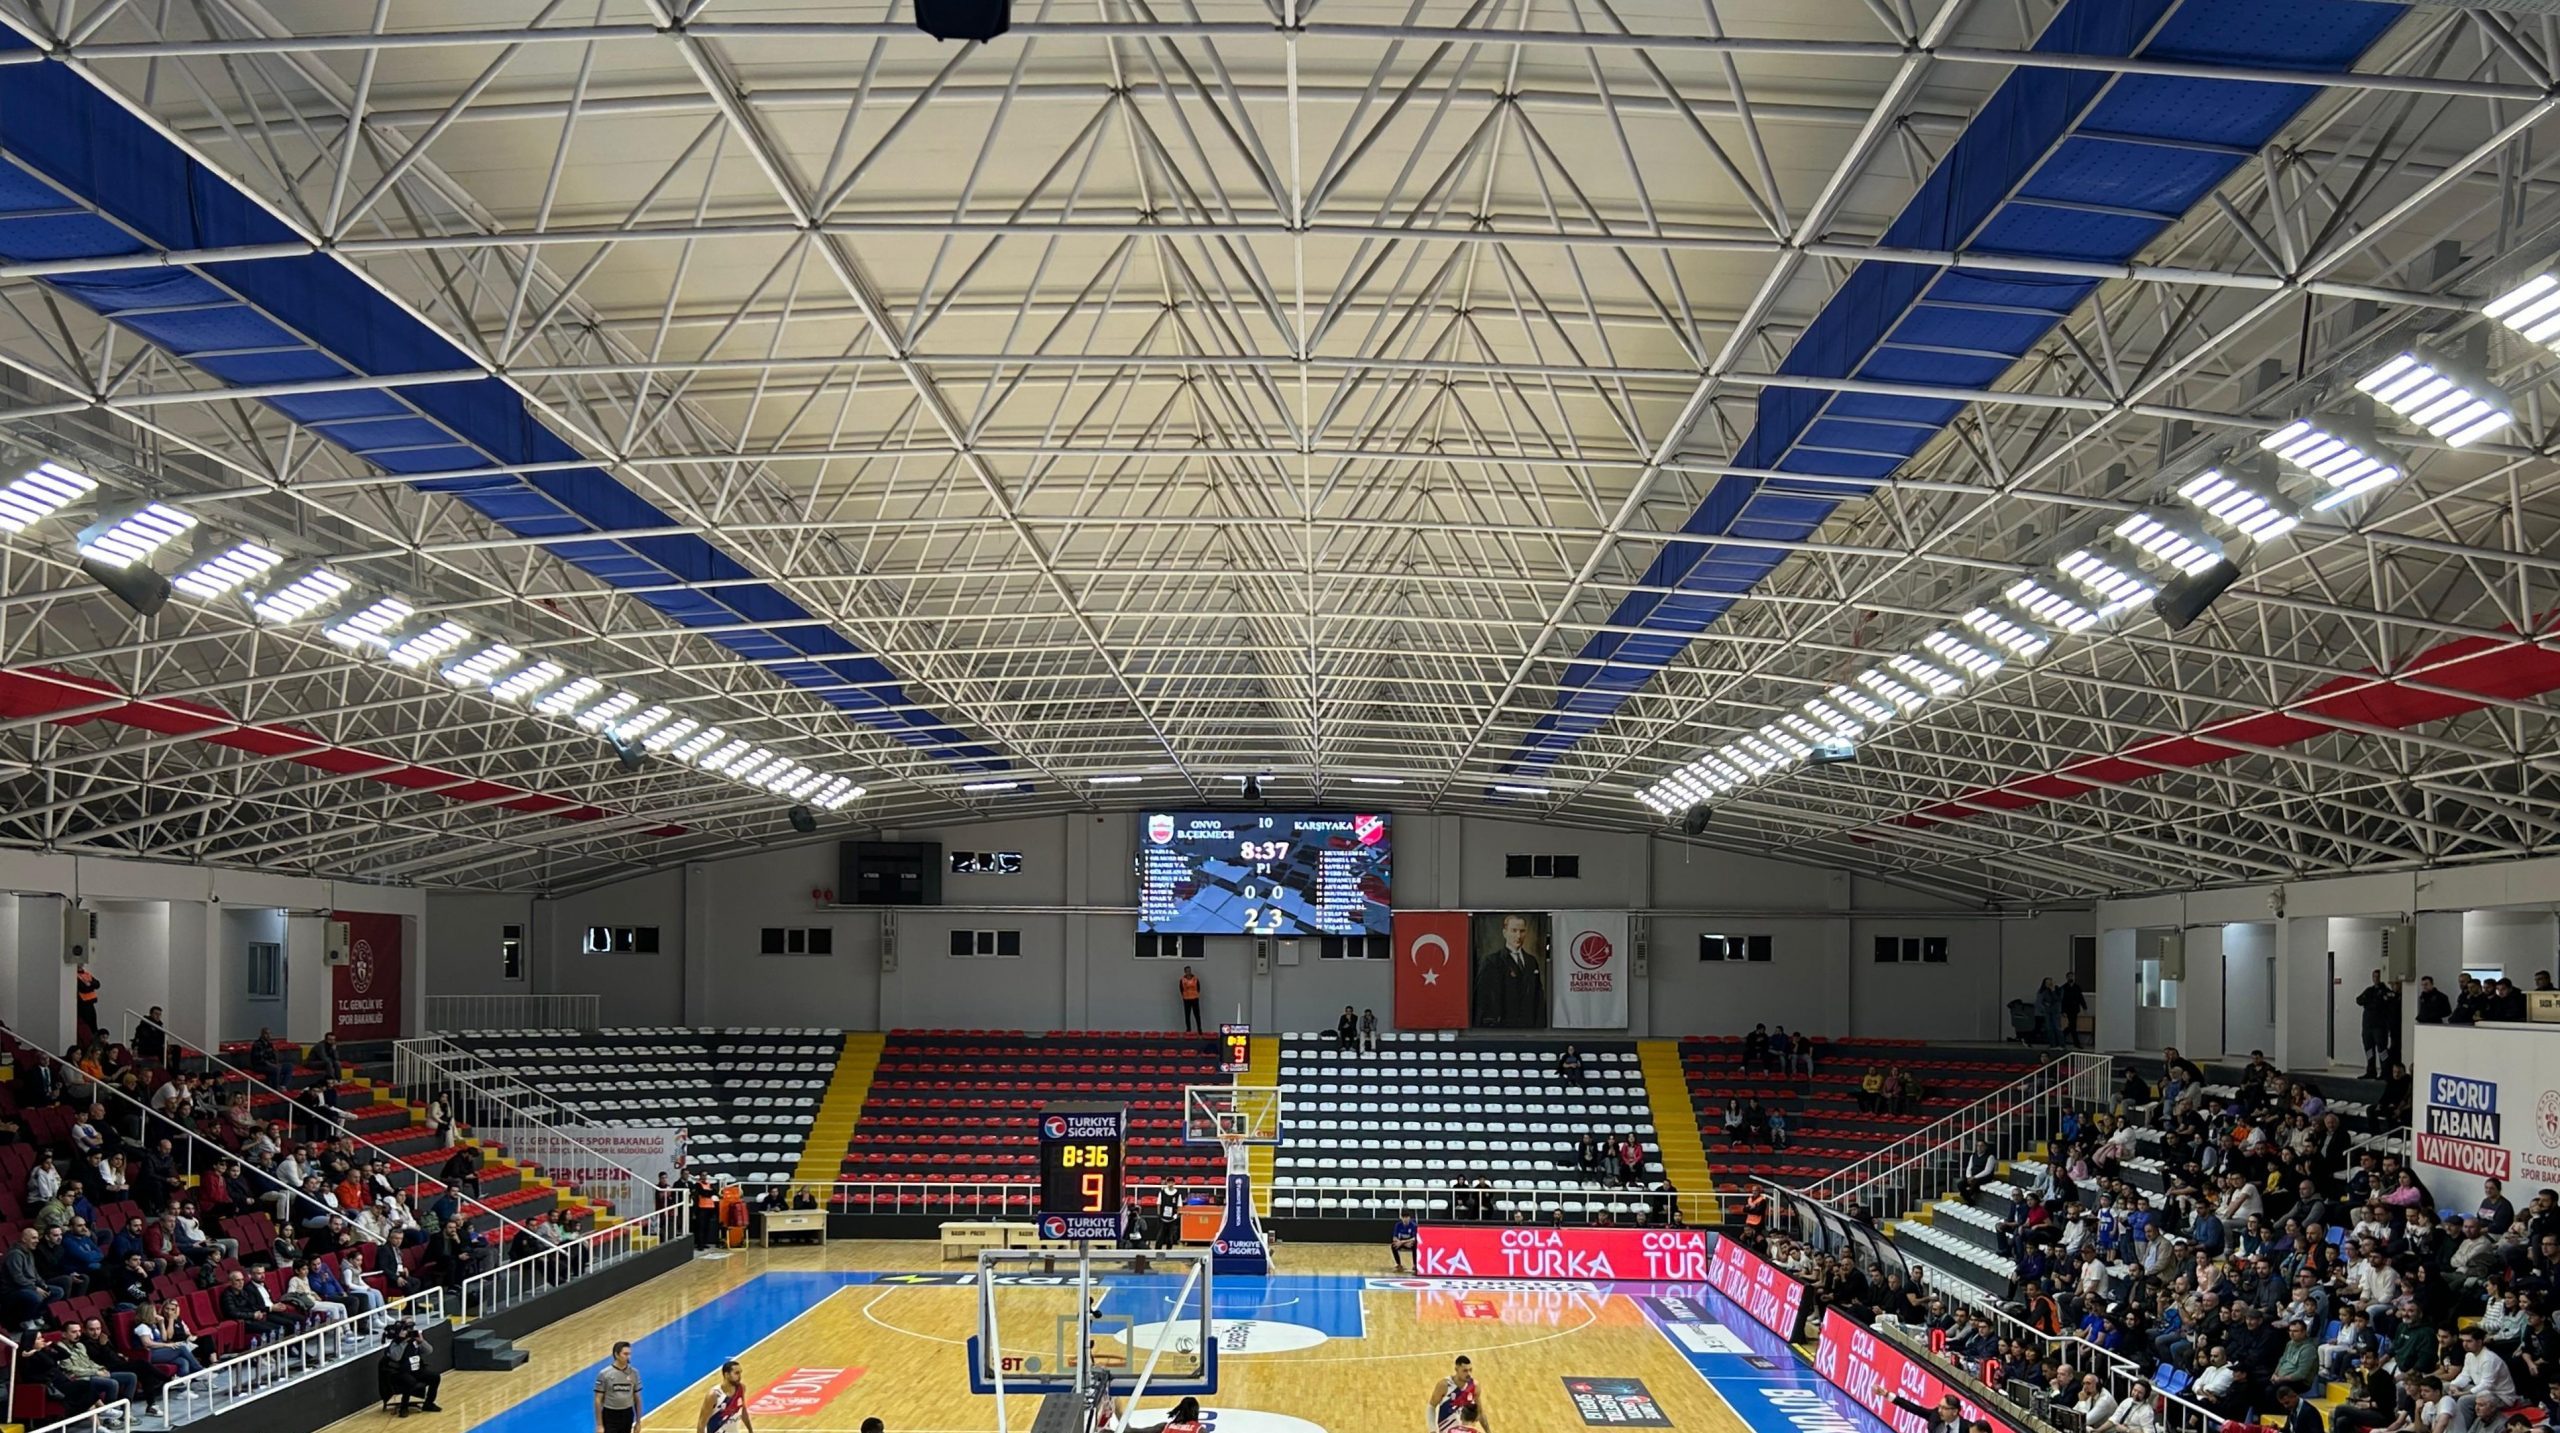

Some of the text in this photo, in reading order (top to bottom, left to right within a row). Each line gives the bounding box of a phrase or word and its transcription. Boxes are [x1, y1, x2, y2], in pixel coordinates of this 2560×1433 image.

[1190, 821, 1221, 829] ONVO
[1259, 818, 1273, 828] 10
[1294, 821, 1354, 831] KARŞIYAKA
[1177, 830, 1235, 840] B.ÇEKMECE
[1241, 841, 1290, 860] 8:37
[1244, 885, 1256, 899] 0
[1272, 885, 1284, 899] 0
[1244, 908, 1259, 927] 2
[1268, 908, 1283, 928] 3
[1570, 971, 1612, 981] TÜRKİYE
[1235, 1046, 1245, 1063] 9
[2437, 1077, 2490, 1111] SPORU
[2431, 1109, 2495, 1141] TABANA
[586, 1137, 611, 1145] SPOR
[613, 1136, 664, 1145] BAKANLIĞI
[1063, 1146, 1109, 1167] 8:36
[2420, 1135, 2507, 1178] YAYIYORUZ
[2521, 1152, 2534, 1164] T.C.
[2521, 1168, 2540, 1181] SPOR
[1082, 1174, 1103, 1211] 9
[1501, 1230, 1562, 1247] COLA
[1642, 1232, 1705, 1250] COLA
[1501, 1249, 1615, 1278] TURKA
[1642, 1251, 1708, 1280] TUR
[1731, 1247, 1746, 1269] COLA
[1757, 1263, 1774, 1288] COLA
[1724, 1265, 1750, 1308] TURKA
[1749, 1282, 1779, 1329] TURKA
[1851, 1329, 1875, 1362] COLA
[771, 1368, 846, 1394] ING
[1901, 1362, 1925, 1399] COLA
